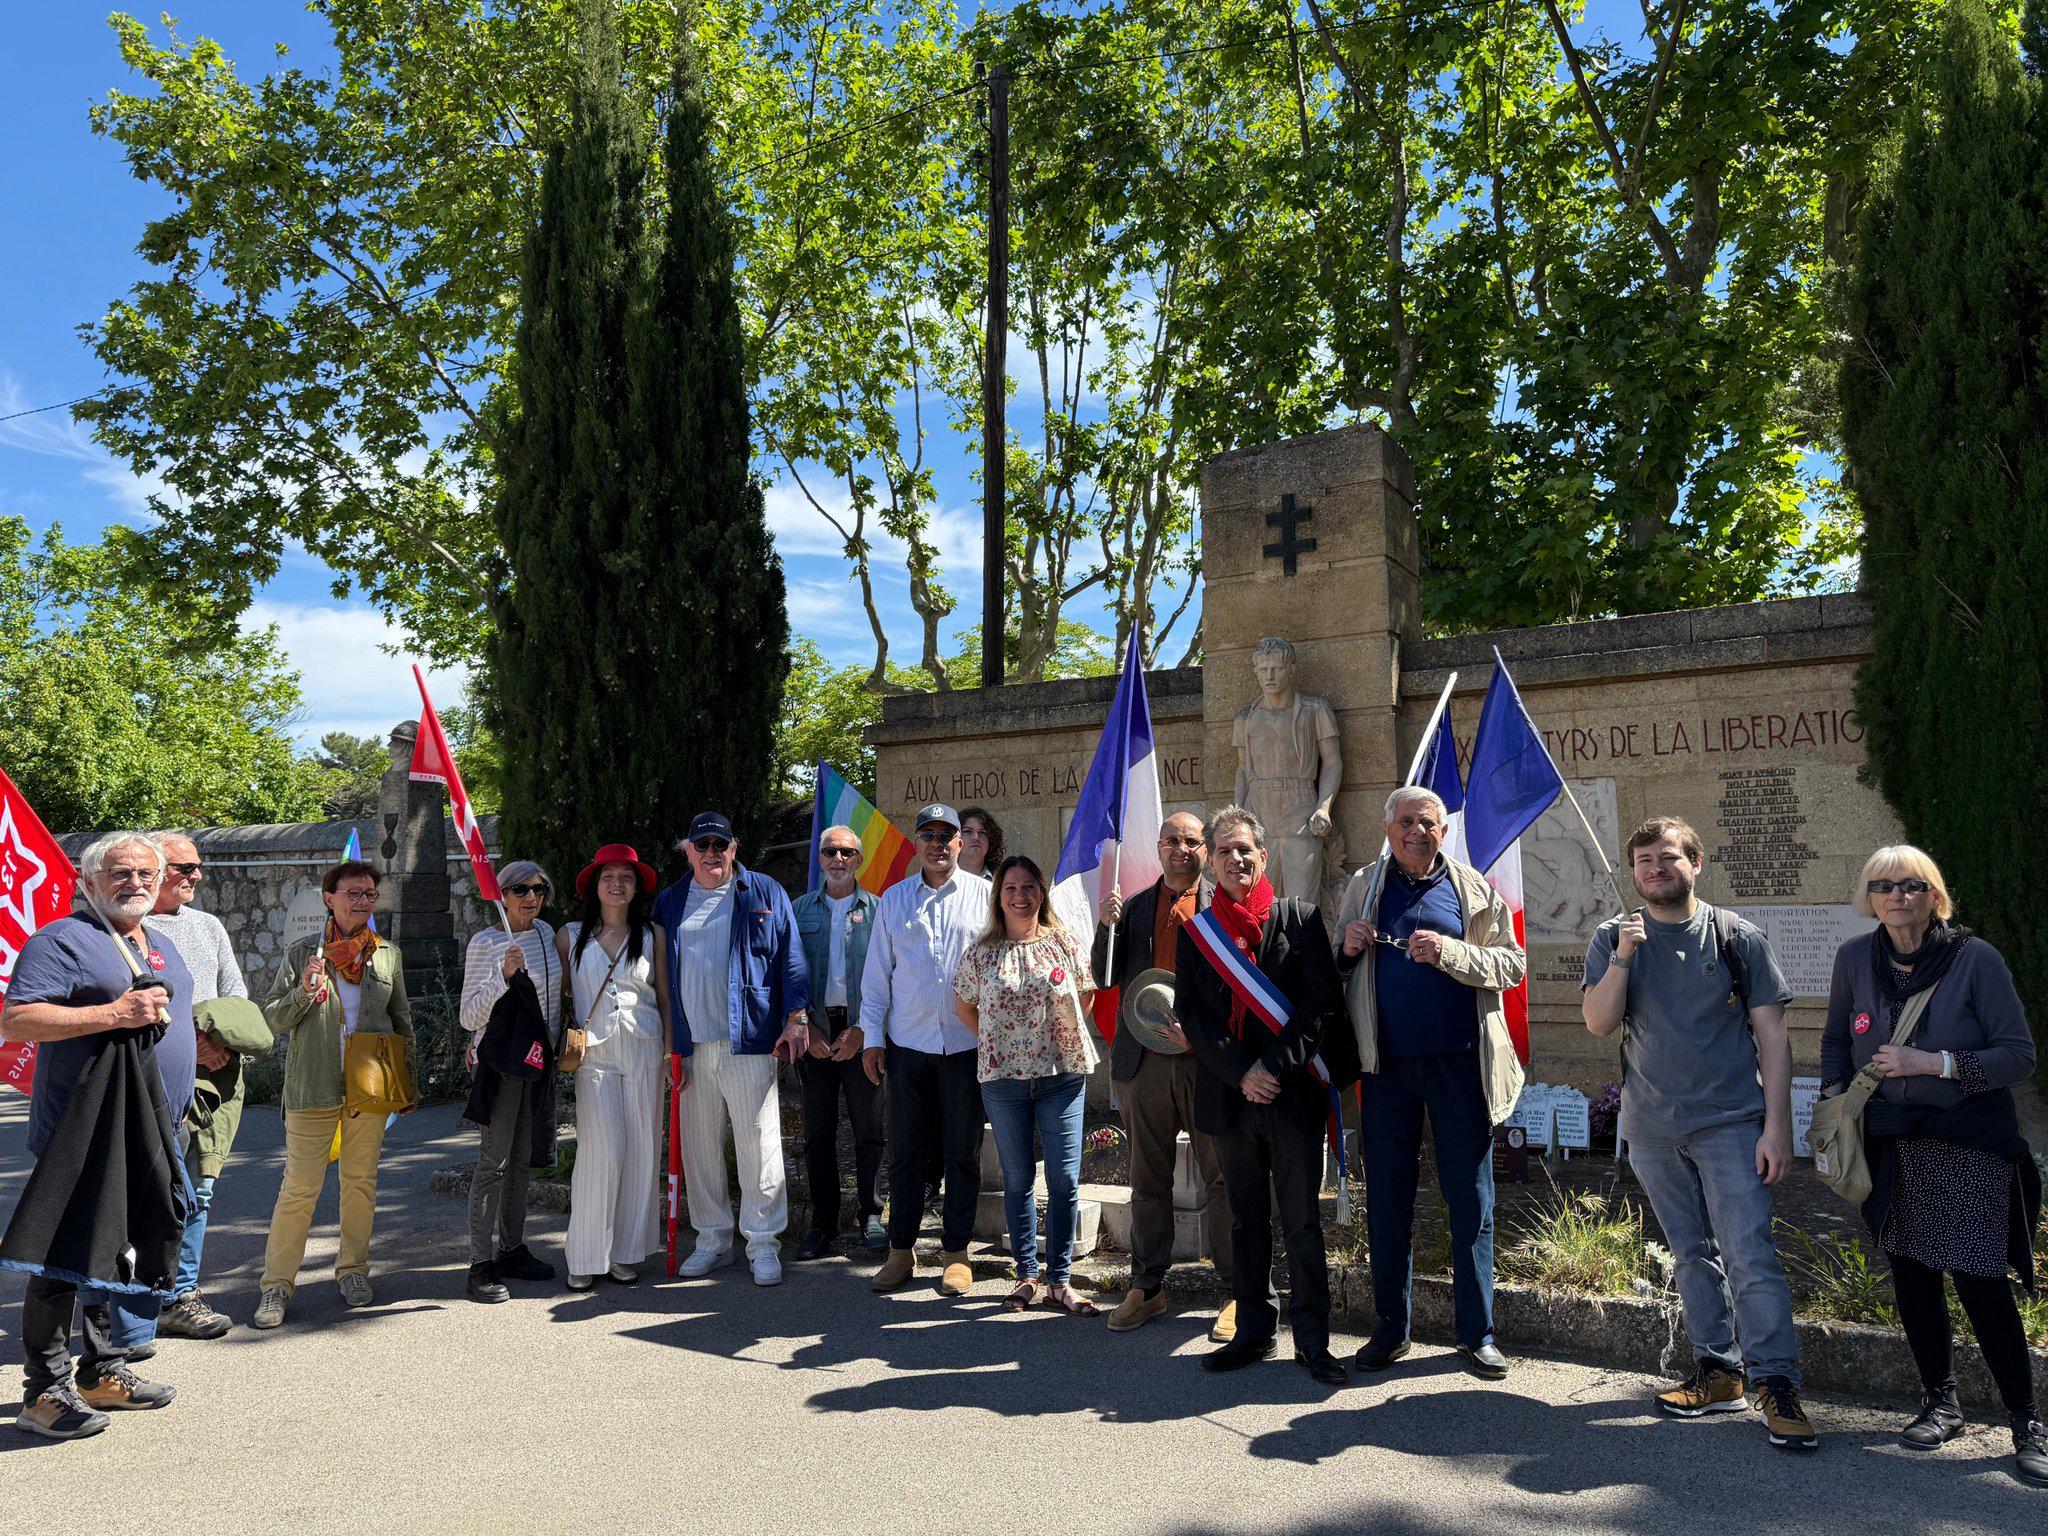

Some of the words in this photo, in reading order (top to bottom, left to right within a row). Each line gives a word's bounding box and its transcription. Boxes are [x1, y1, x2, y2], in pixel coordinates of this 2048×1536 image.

[1542, 727, 1598, 761] TYRS
[1610, 724, 1641, 758] DE
[1652, 721, 1692, 756] LA
[1703, 709, 1865, 752] LIBERATIO
[1747, 767, 1796, 778] RAYMOND
[904, 775, 940, 803] AUX
[952, 770, 1006, 800] HEROS
[1019, 769, 1041, 796] DE
[1052, 765, 1080, 794] LA
[1163, 757, 1199, 787] NCE
[1726, 780, 1751, 788] NOAT
[1725, 789, 1759, 798] KUNTZ
[1763, 788, 1794, 796] EMILE
[1755, 796, 1799, 805] AUGUSTE
[1767, 815, 1807, 825] GASTON
[1773, 824, 1797, 833] JEAN
[1764, 834, 1793, 843] LOUIS
[1710, 854, 1722, 862] DE
[1758, 869, 1799, 878] FRANCIS
[1771, 878, 1802, 887] EMILE
[1773, 887, 1796, 896] MAX
[1760, 908, 1829, 917] DEPORTATION
